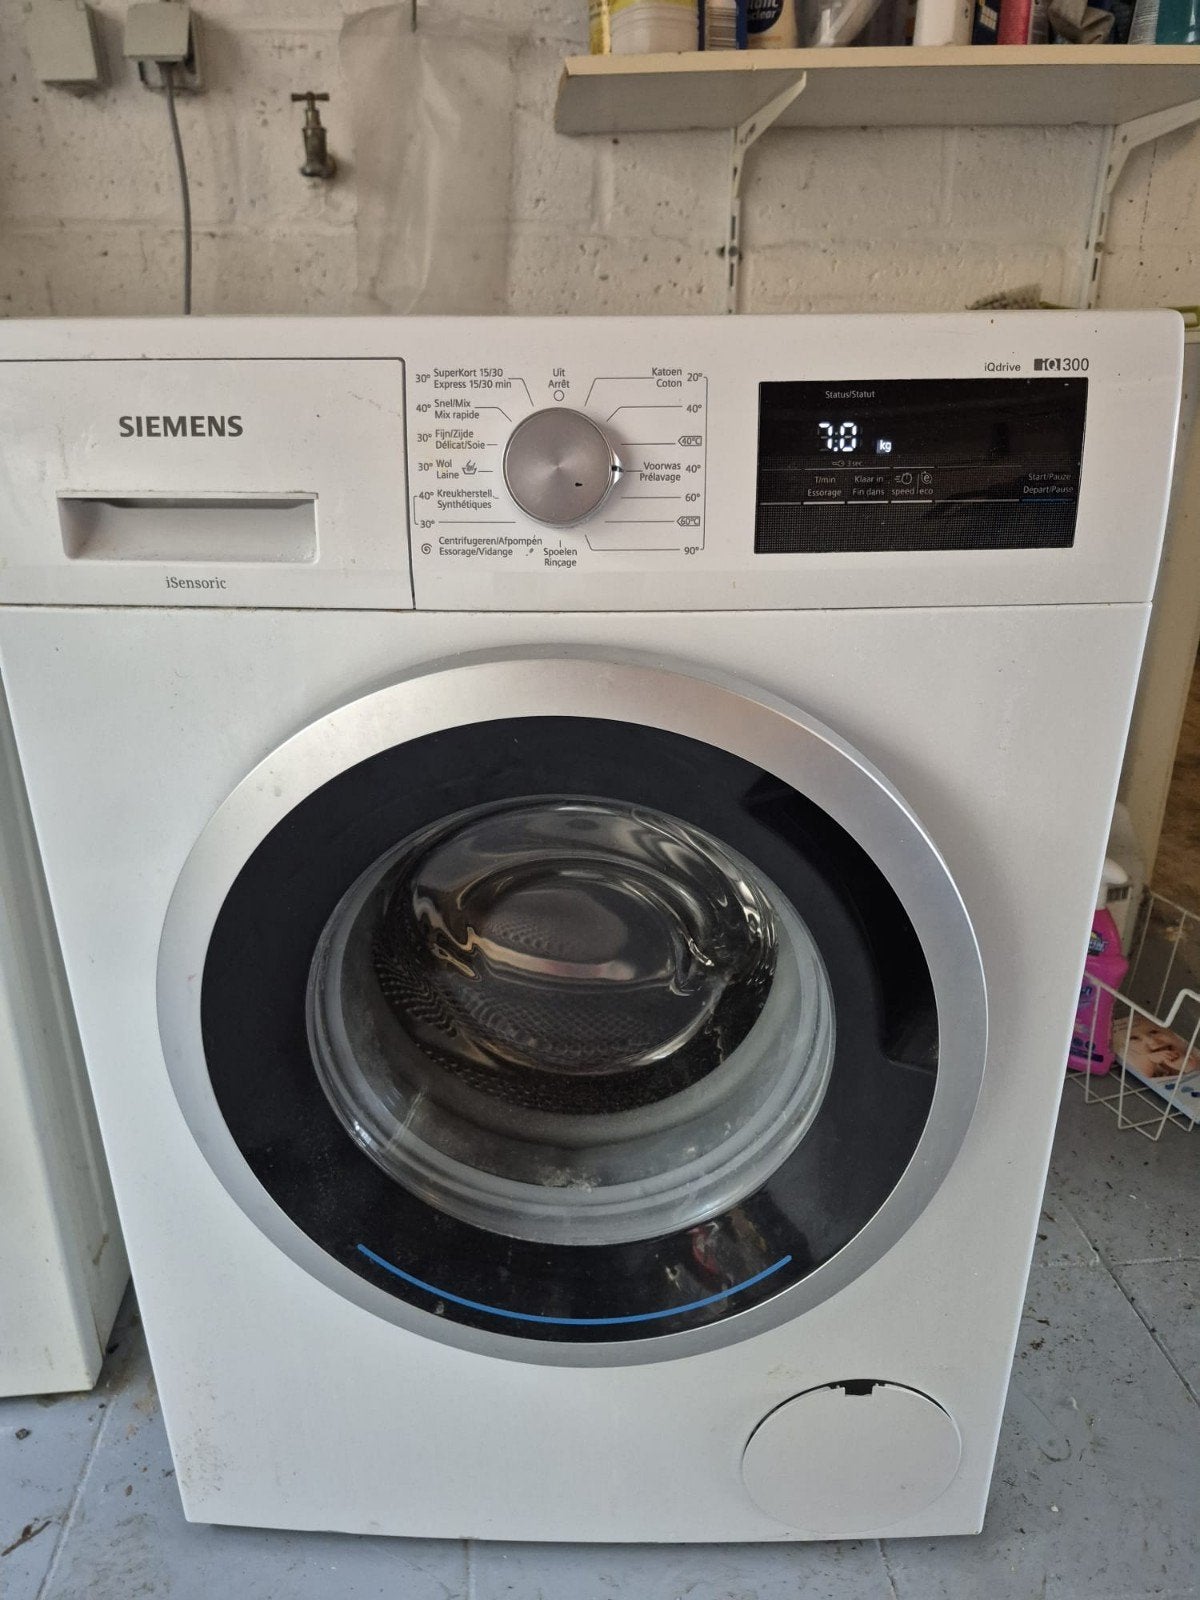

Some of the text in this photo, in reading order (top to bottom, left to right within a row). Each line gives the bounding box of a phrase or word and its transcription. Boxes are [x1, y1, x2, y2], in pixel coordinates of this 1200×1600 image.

[552, 367, 565, 377] Uit
[651, 367, 682, 376] Katoen
[984, 362, 1021, 372] iQdrive
[415, 374, 431, 383] 30°
[433, 368, 503, 379] SuperKort 15/30
[433, 380, 512, 390] Express 15/30 min
[548, 379, 570, 389] Arrêt
[656, 379, 682, 388] Coton
[825, 390, 875, 399] Status/Statut
[416, 403, 431, 413] 40°
[434, 398, 471, 408] Snel/Mix
[686, 404, 702, 413] 40°
[434, 410, 480, 421] Mix rapide
[118, 415, 244, 438] SIEMENS
[417, 433, 432, 443] 30°
[435, 429, 474, 440] Fijn/Zijde
[435, 440, 485, 449] Délicat/Soie
[879, 439, 892, 453] kg
[418, 462, 433, 472] 30°
[436, 459, 452, 468] Wol
[643, 461, 681, 470] Voorwas
[685, 464, 701, 473] 40°
[436, 470, 459, 479] Laine
[639, 472, 681, 483] Prélavage
[854, 475, 874, 483] Klaar
[1028, 472, 1072, 481] Start/Pauze
[418, 491, 434, 500] 40°
[437, 489, 495, 498] Kreukherstell.
[807, 488, 842, 498] Essorage
[866, 487, 885, 495] dans
[891, 488, 915, 496] speed
[685, 493, 701, 502] 60°
[437, 499, 492, 511] Synthétiques
[420, 519, 435, 529] 30°
[438, 536, 543, 548] Centrifugeren/Afpompen
[439, 547, 513, 558] Essorage/Vidange
[543, 548, 578, 558] Spoelen
[684, 546, 699, 555] 90°
[544, 558, 577, 568] Rinçage
[165, 576, 227, 590] iSensoric
